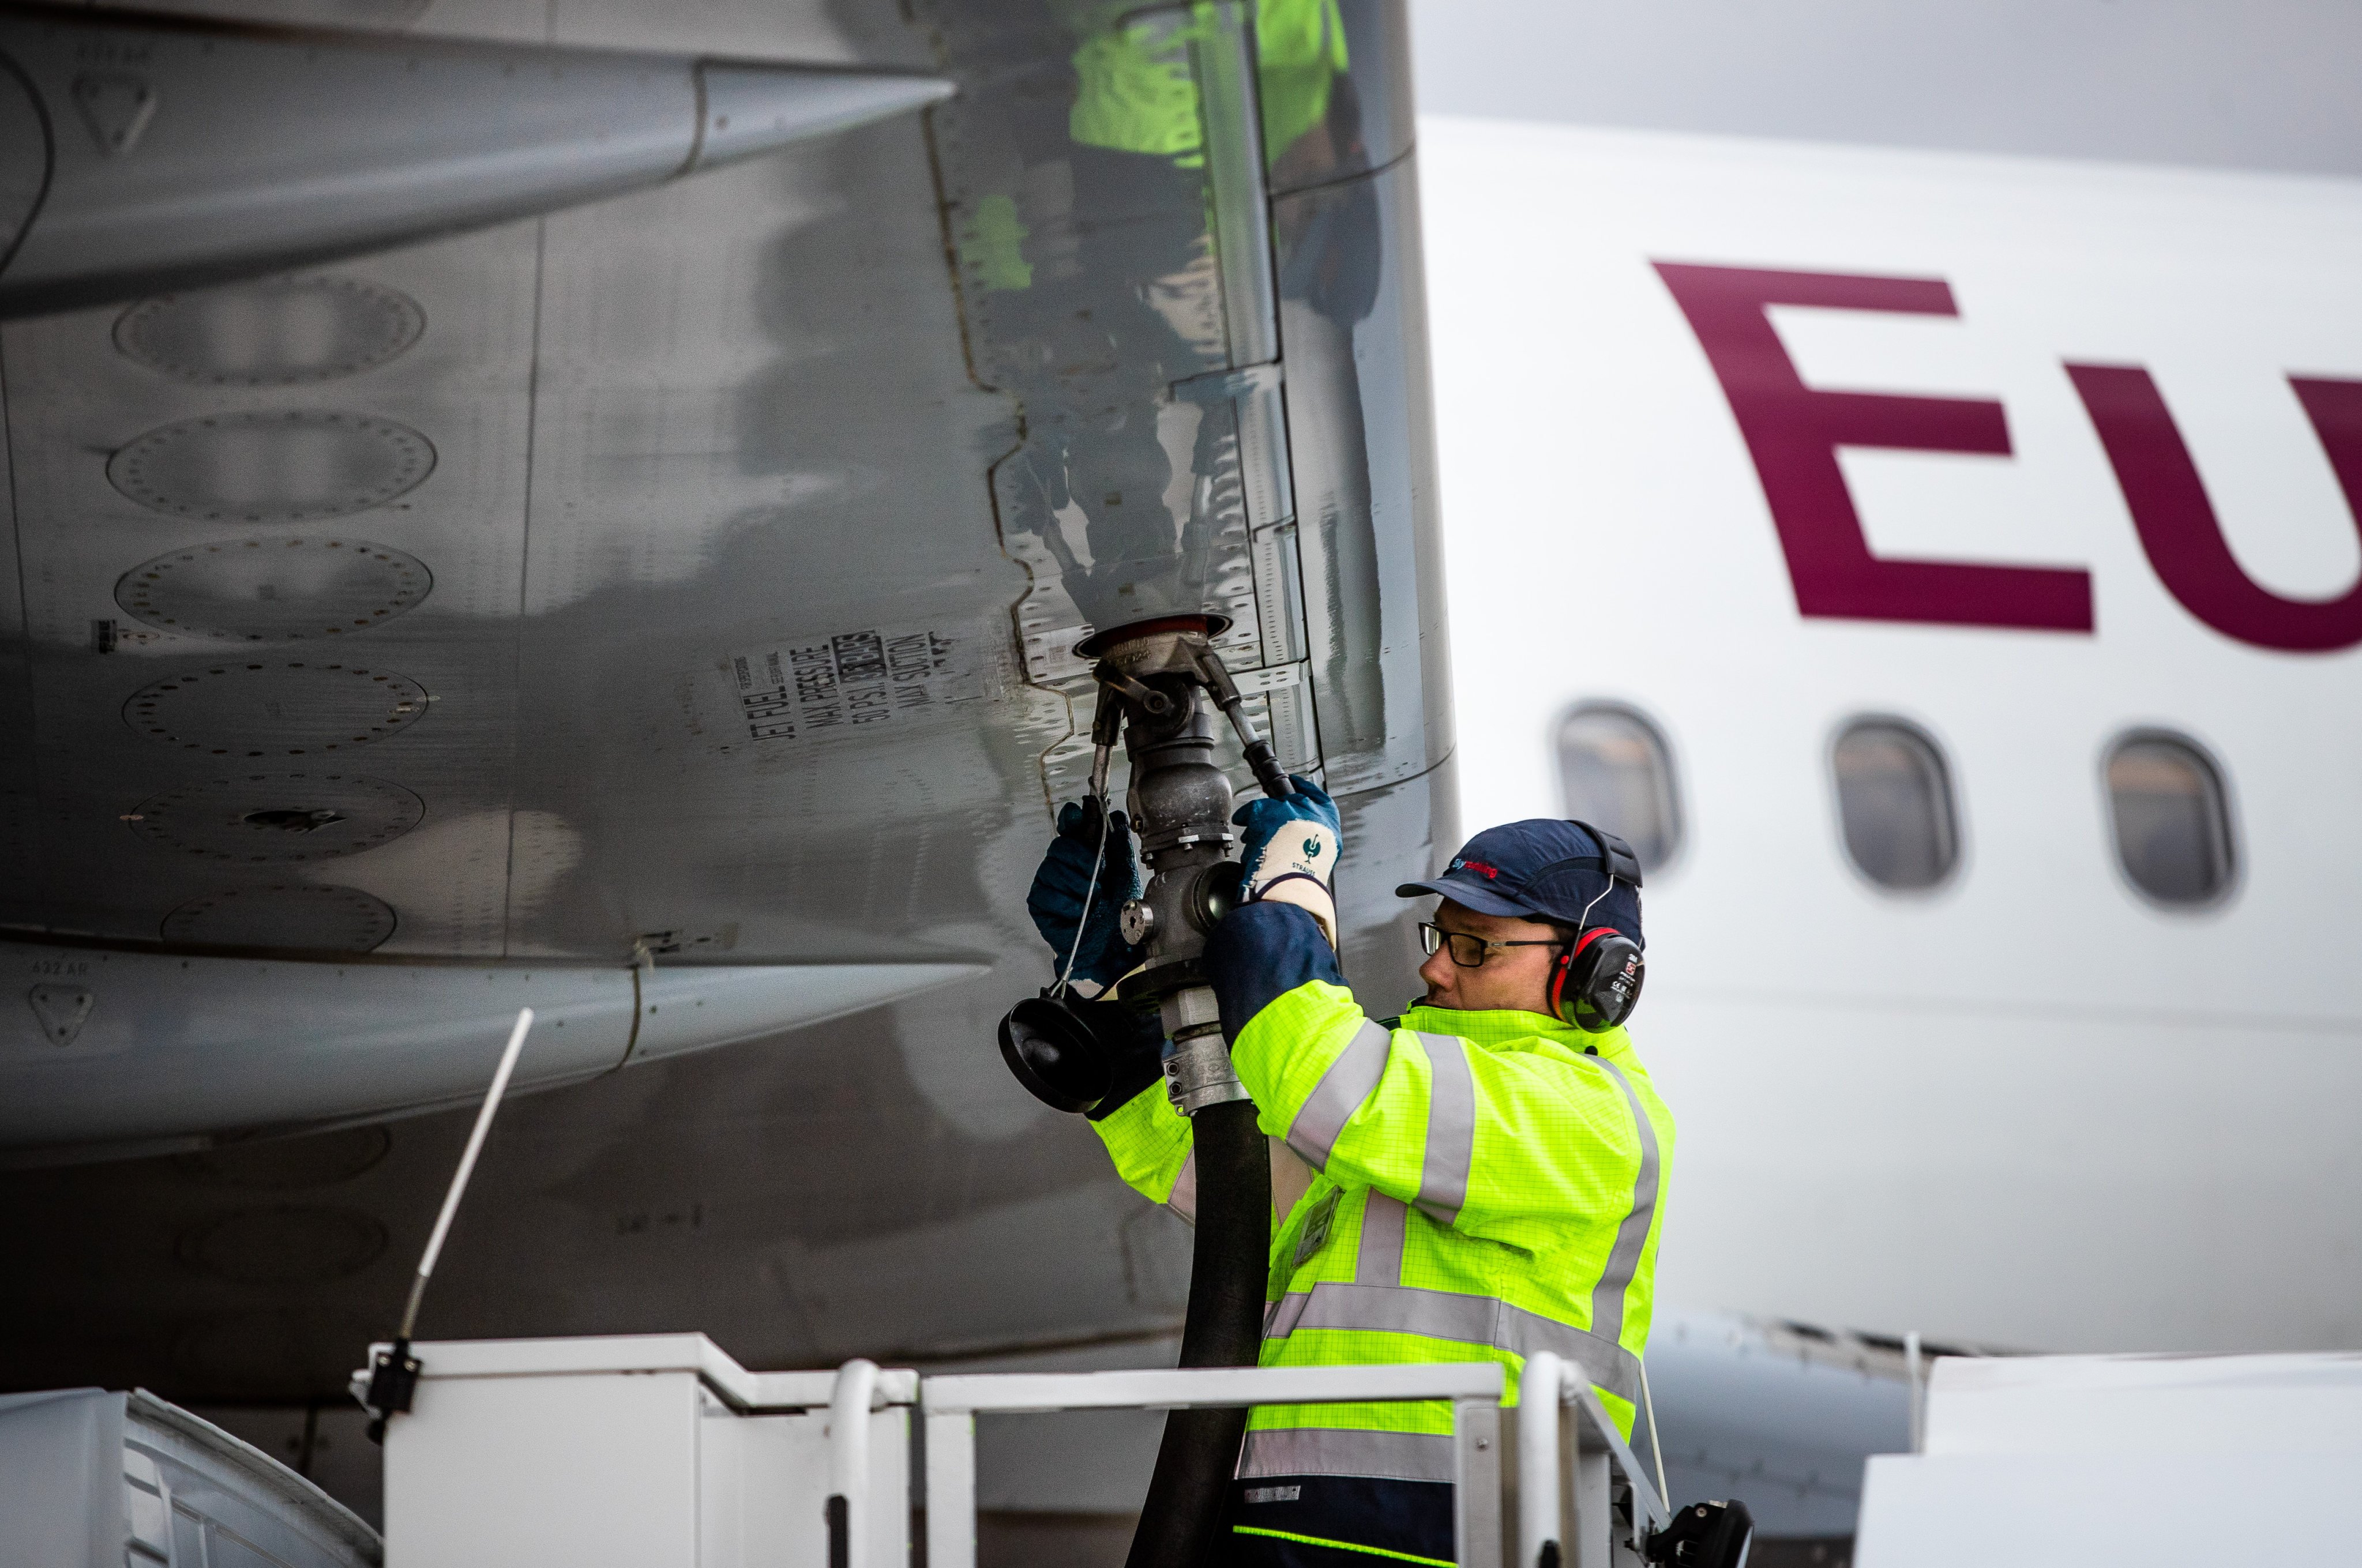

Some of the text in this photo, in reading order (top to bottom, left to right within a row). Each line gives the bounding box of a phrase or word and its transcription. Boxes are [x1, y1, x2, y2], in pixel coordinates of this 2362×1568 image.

[836, 631, 880, 664] BARS
[790, 644, 844, 728] MAX PRESSURE
[885, 634, 936, 709] MAX SUCTION
[743, 685, 796, 741] JET FUEL
[852, 709, 891, 724] 50
[1291, 862, 1316, 877] STRAUSS
